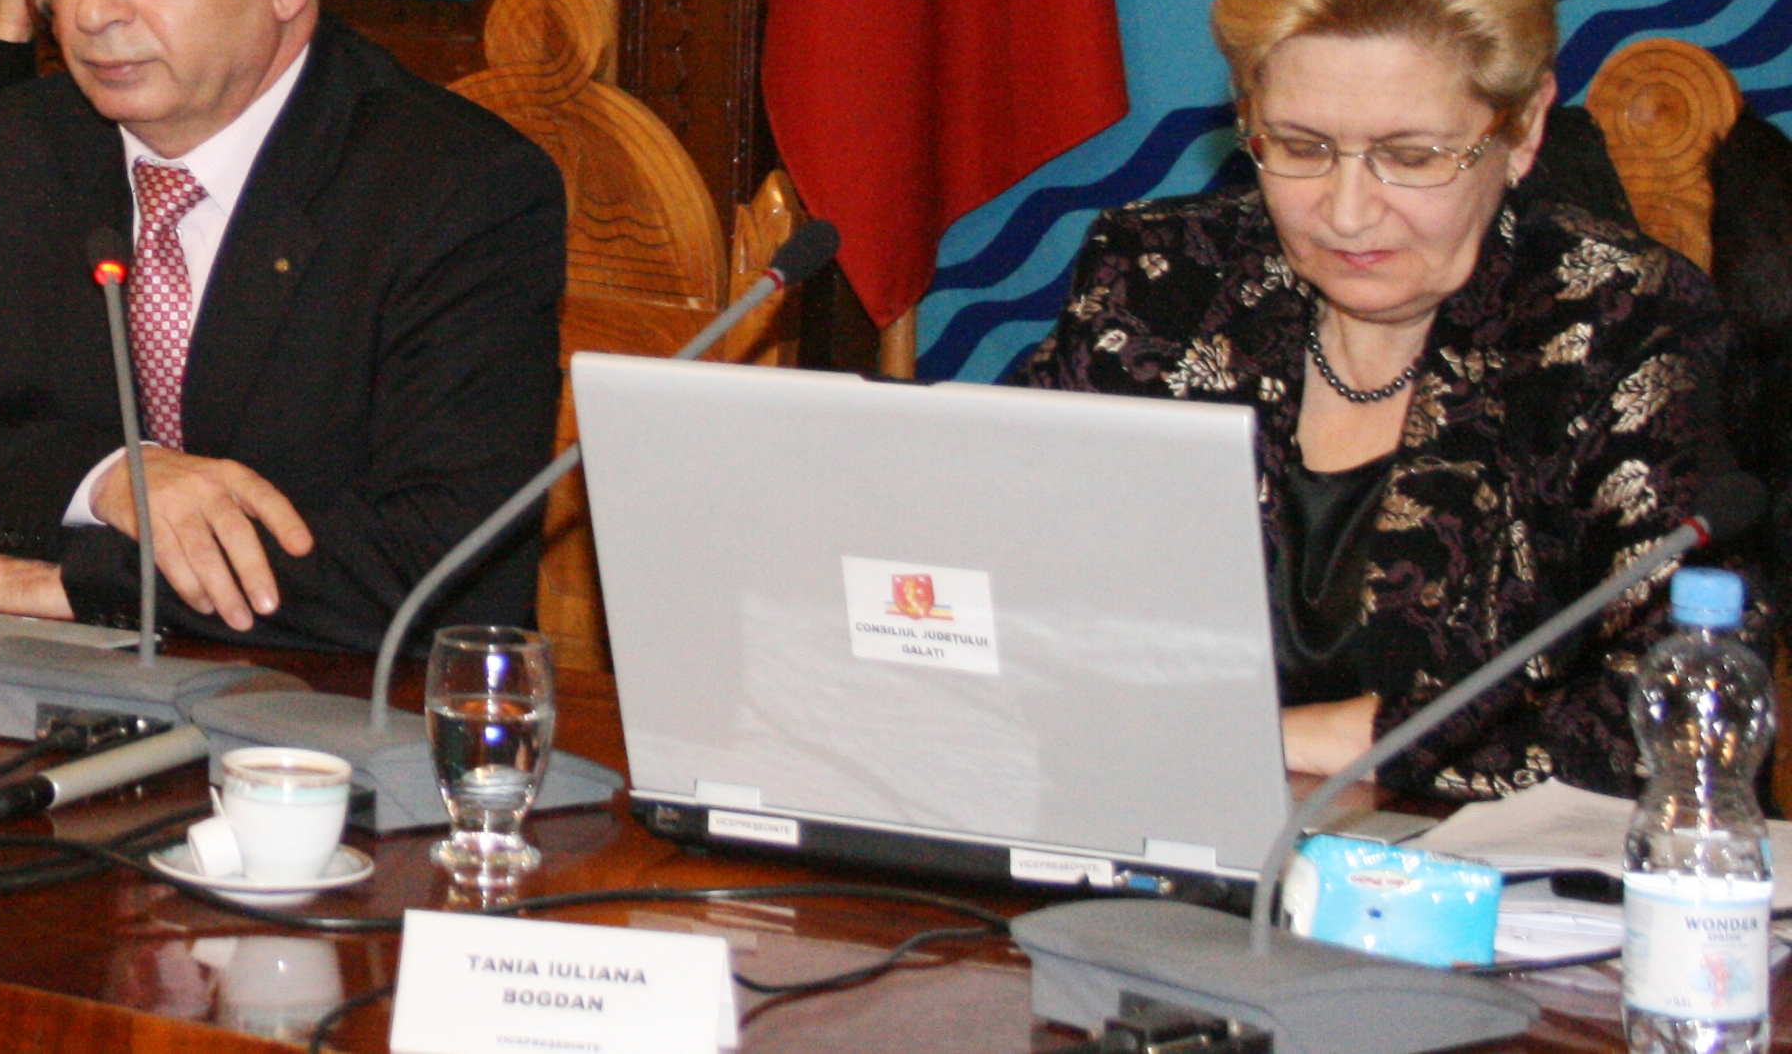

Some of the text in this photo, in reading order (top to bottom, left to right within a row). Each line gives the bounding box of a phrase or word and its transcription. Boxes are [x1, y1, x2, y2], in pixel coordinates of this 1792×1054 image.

[855, 622, 917, 637] CONSILIUL
[1683, 915, 1758, 931] WONDER
[466, 953, 648, 984] TANIA IULIANA
[502, 988, 605, 1012] BOGDAN
